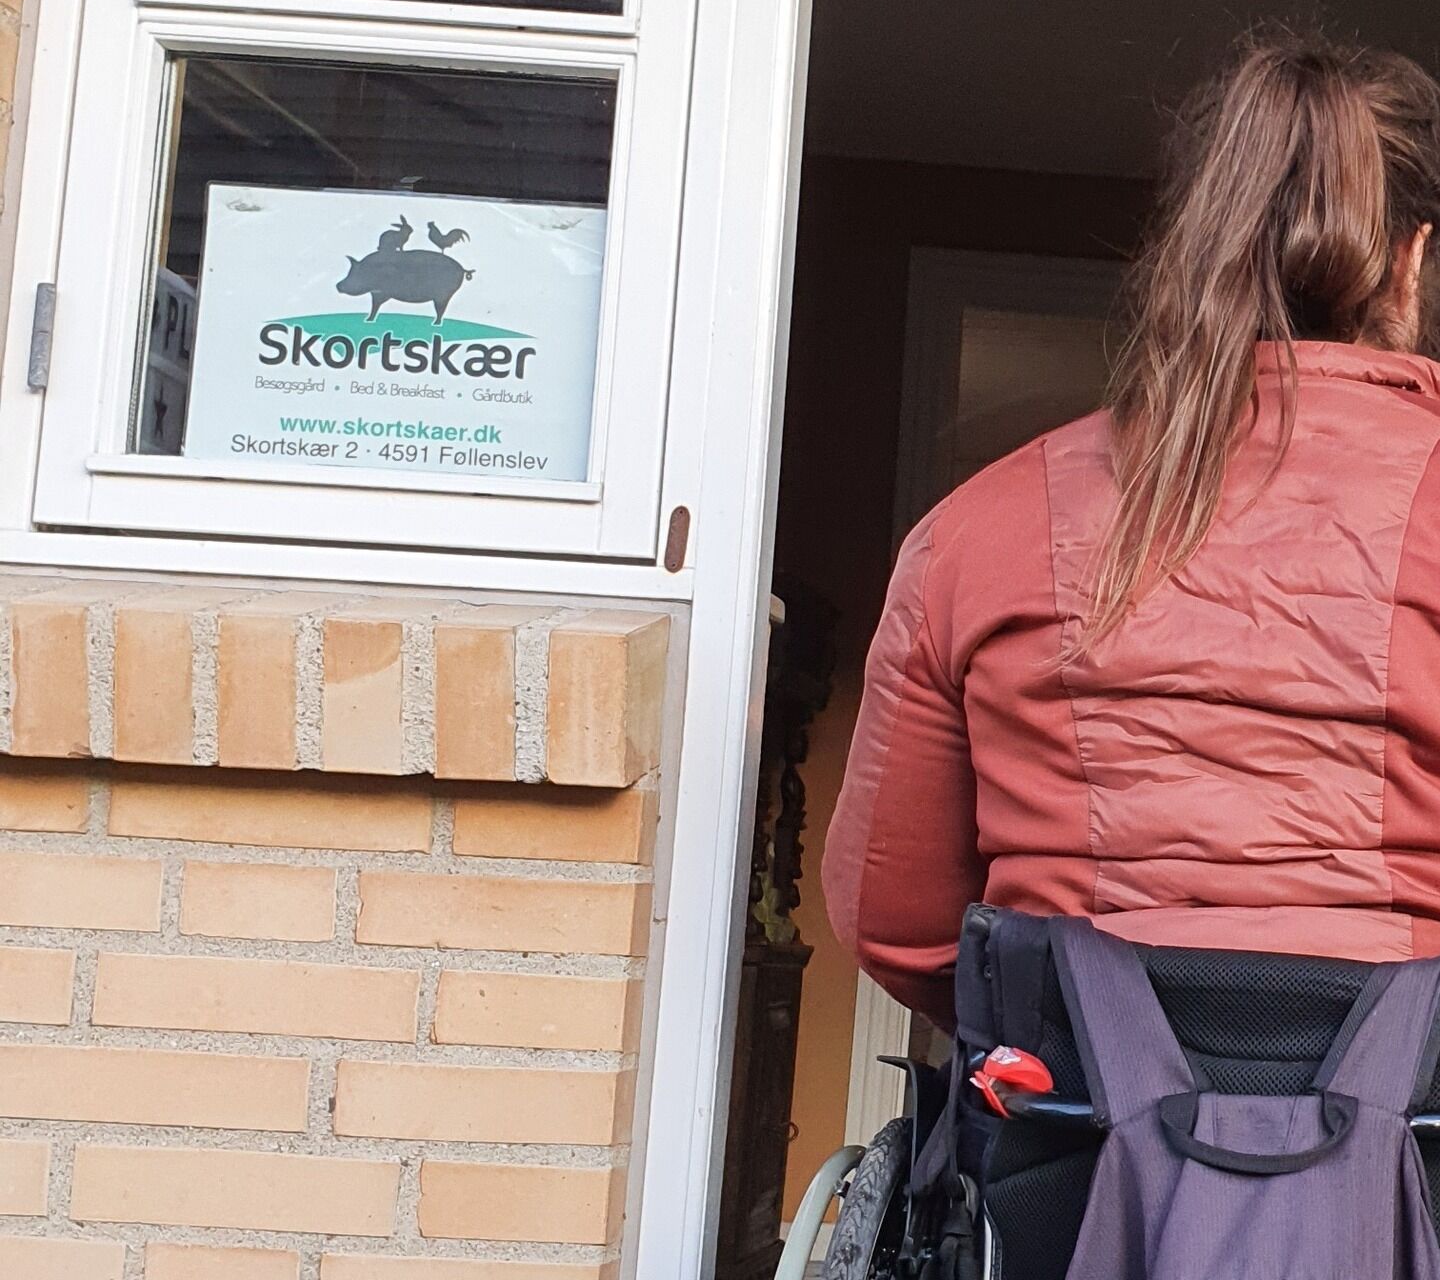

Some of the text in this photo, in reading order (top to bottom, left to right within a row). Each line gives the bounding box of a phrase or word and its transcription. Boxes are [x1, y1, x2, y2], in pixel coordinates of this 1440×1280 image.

[258, 324, 537, 379] Skortskær
[350, 380, 374, 395] Bed
[377, 382, 387, 396] &
[390, 383, 445, 400] Breakfast
[472, 387, 533, 405] Gårdbutik
[280, 416, 502, 444] www.skortskaer.dk
[231, 433, 549, 472] Skortskær 2 4591 Føllenslev
